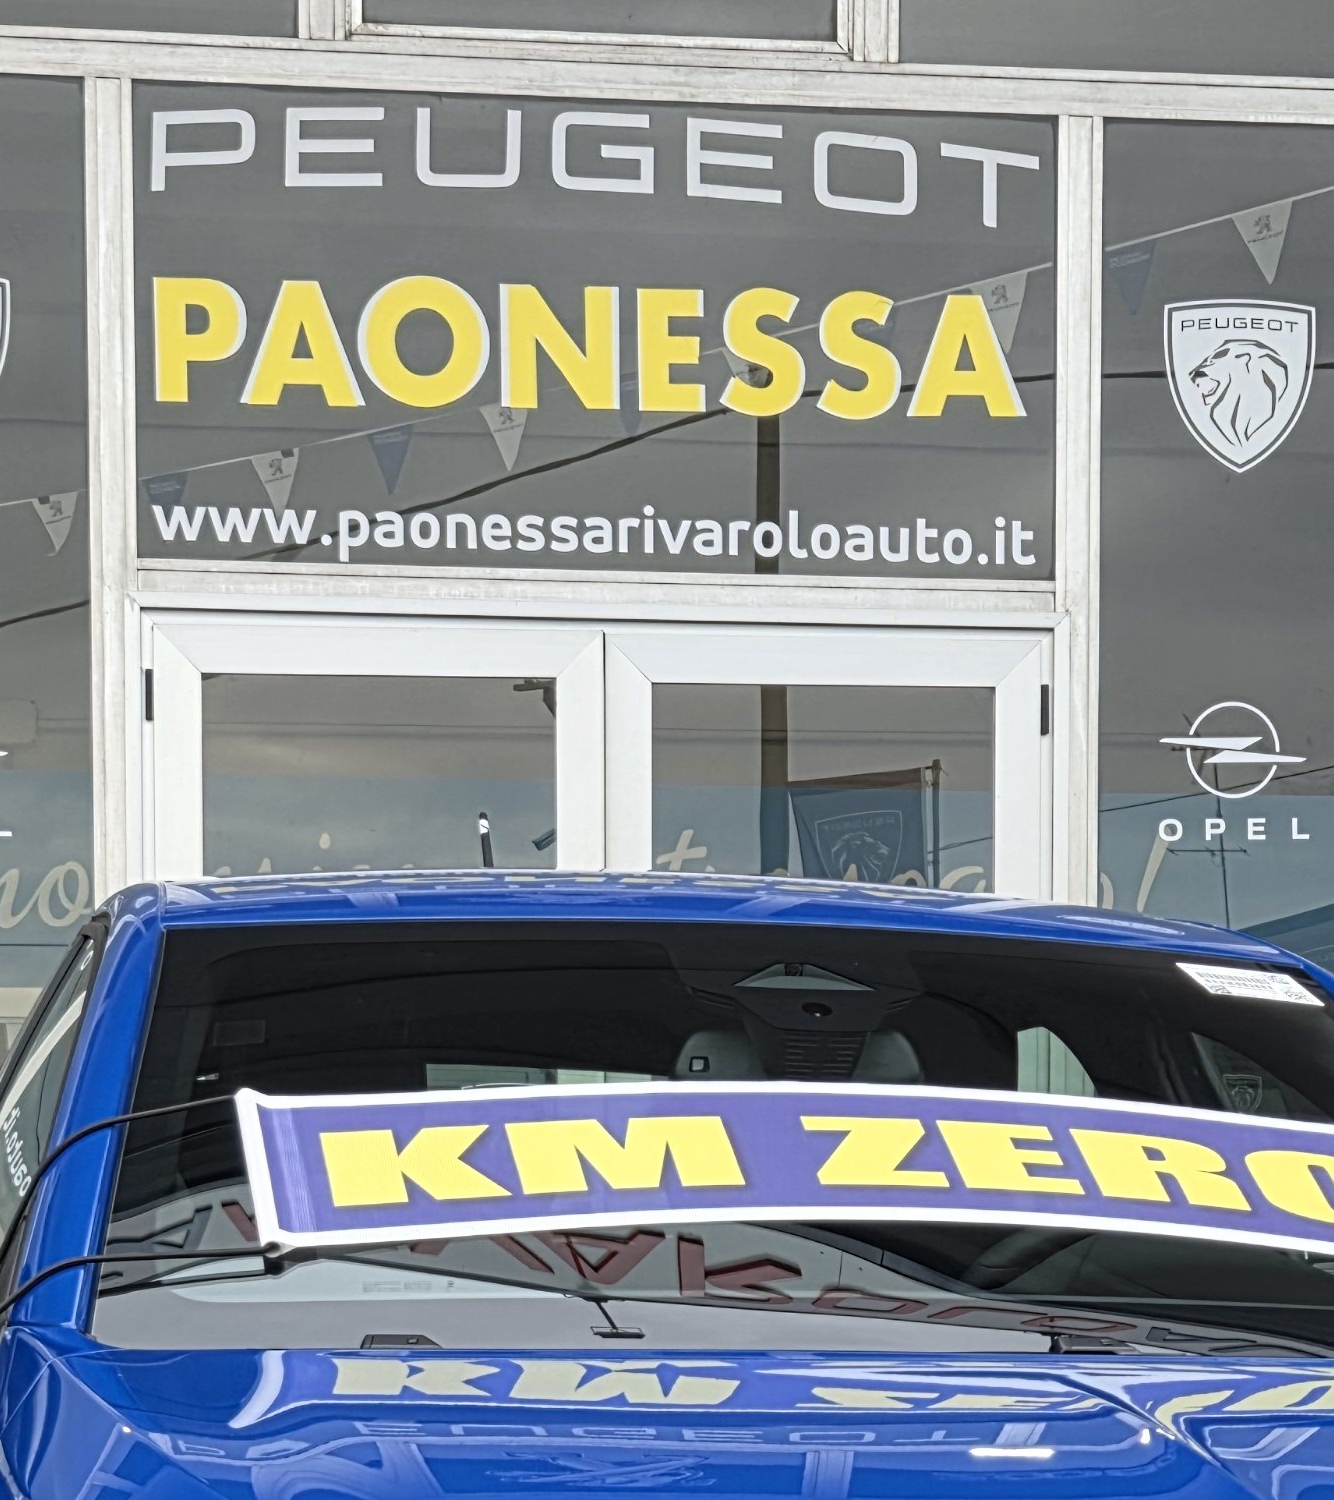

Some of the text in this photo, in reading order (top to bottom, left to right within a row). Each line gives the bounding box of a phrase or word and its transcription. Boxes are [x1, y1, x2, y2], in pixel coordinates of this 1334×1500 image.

[150, 105, 1041, 229] PEUGEOT
[152, 275, 1028, 420] PAONESSA
[1180, 317, 1299, 334] PEUGEOT
[152, 504, 1037, 567] www.paonessarivaroloauto.it
[1158, 817, 1310, 841] OPEL
[319, 1113, 747, 1209] KM
